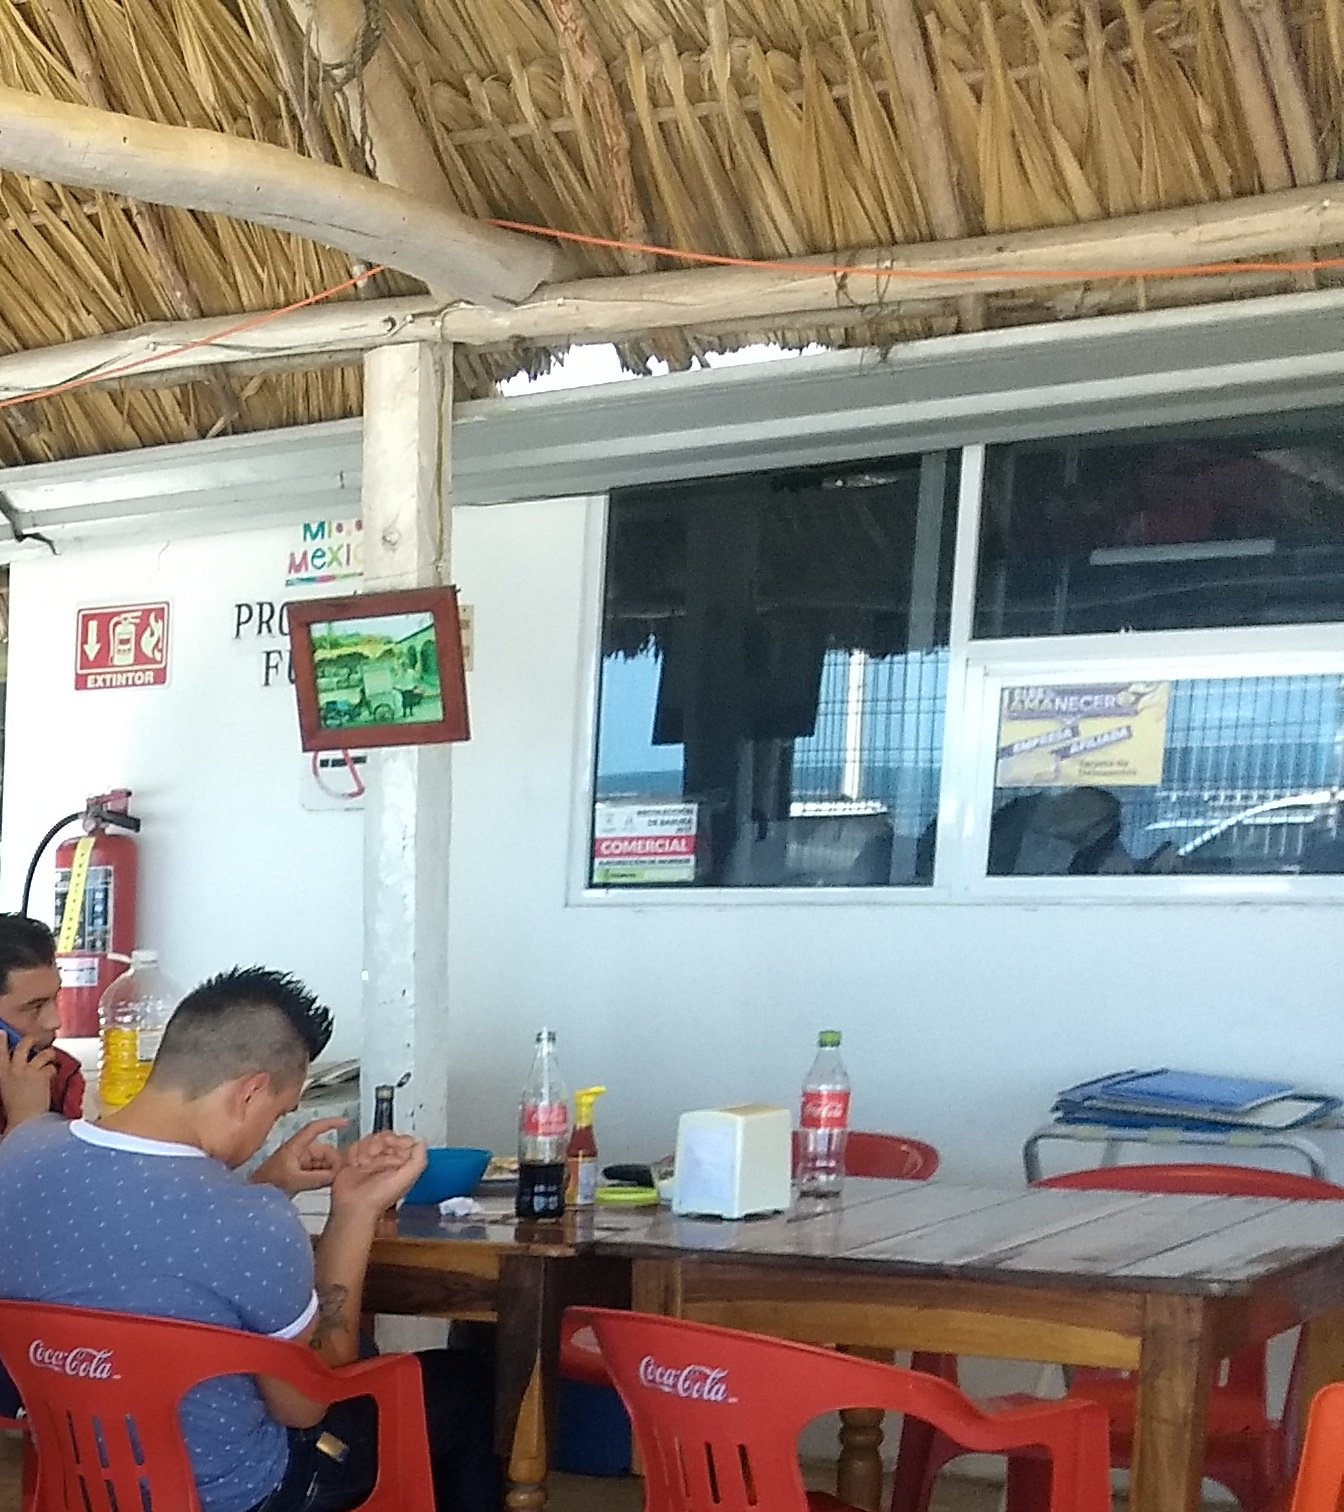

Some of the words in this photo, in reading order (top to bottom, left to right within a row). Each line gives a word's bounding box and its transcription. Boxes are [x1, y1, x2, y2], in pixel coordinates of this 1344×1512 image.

[86, 671, 155, 689] EXTINTOR
[1011, 695, 1116, 712] AMANECER
[600, 838, 688, 855] COMERCIAL
[29, 1339, 114, 1380] Coca-Cola
[639, 1355, 729, 1403] Coca-Cola
